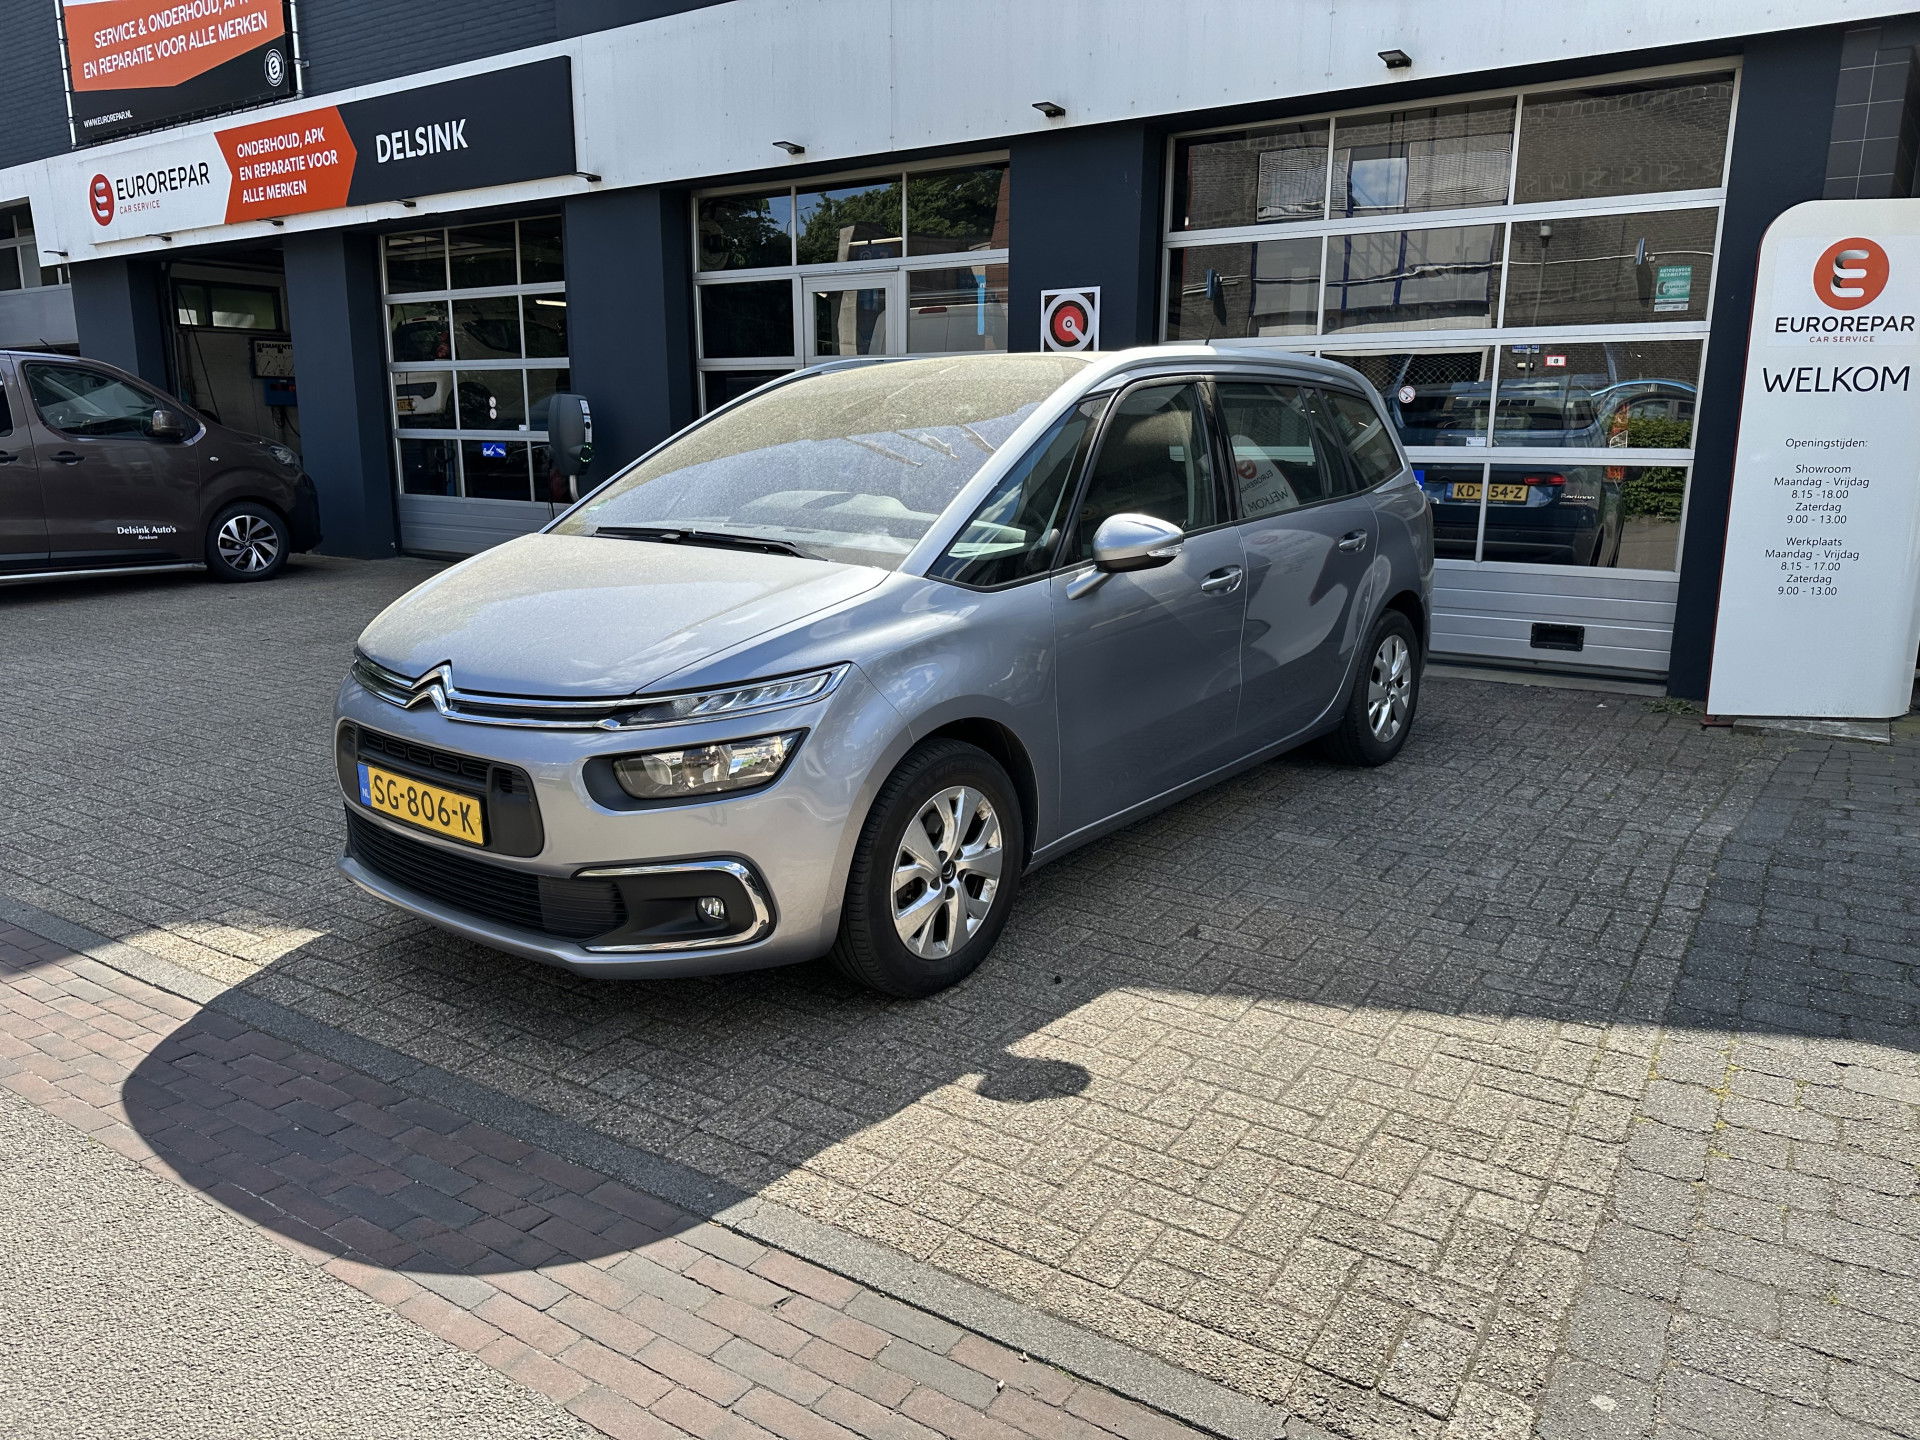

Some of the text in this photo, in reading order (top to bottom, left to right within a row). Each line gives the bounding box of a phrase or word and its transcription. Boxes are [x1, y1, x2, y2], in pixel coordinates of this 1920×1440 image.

[94, 0, 222, 48] SERVICE & ONDERHOUD,
[84, 10, 268, 79] EN REPARATIE VOOR ALLE MERKEN
[237, 127, 326, 158] ONDERHOUD, APK
[375, 118, 469, 164] DELSINK
[239, 150, 338, 181] EN REPARATIE VOOR
[116, 162, 210, 200] EUROREPAR
[242, 180, 307, 204] ALLE MERKEN
[119, 200, 161, 215] CAR SERVICE
[1775, 315, 1915, 333] EUROREPAR
[1832, 335, 1875, 343] SERVICE
[1762, 365, 1910, 393] WELKOM
[1785, 438, 1868, 449] Openingstijden:
[1795, 464, 1851, 473] Showroom
[1773, 477, 1822, 488] Maandag
[1833, 477, 1870, 488] Vrijdag
[1456, 484, 1523, 500] KD-54-Z
[1791, 489, 1813, 499] 8.15
[1795, 502, 1842, 514] Zaterdag
[1786, 515, 1808, 524] 9.00
[1819, 515, 1847, 524] 13.00
[117, 524, 177, 535] Delsink Auto's
[1785, 537, 1843, 548] Werkplaats
[1765, 549, 1813, 560] Maandag
[1823, 549, 1860, 561] Vrijdag
[1780, 562, 1802, 571] 8.15
[1813, 562, 1841, 571] 17.00
[1786, 574, 1832, 585] Zaterdag
[1777, 586, 1799, 596] 9.00
[1810, 586, 1838, 596] 13.00
[361, 787, 371, 799] NL
[373, 774, 476, 836] SG-806-K
